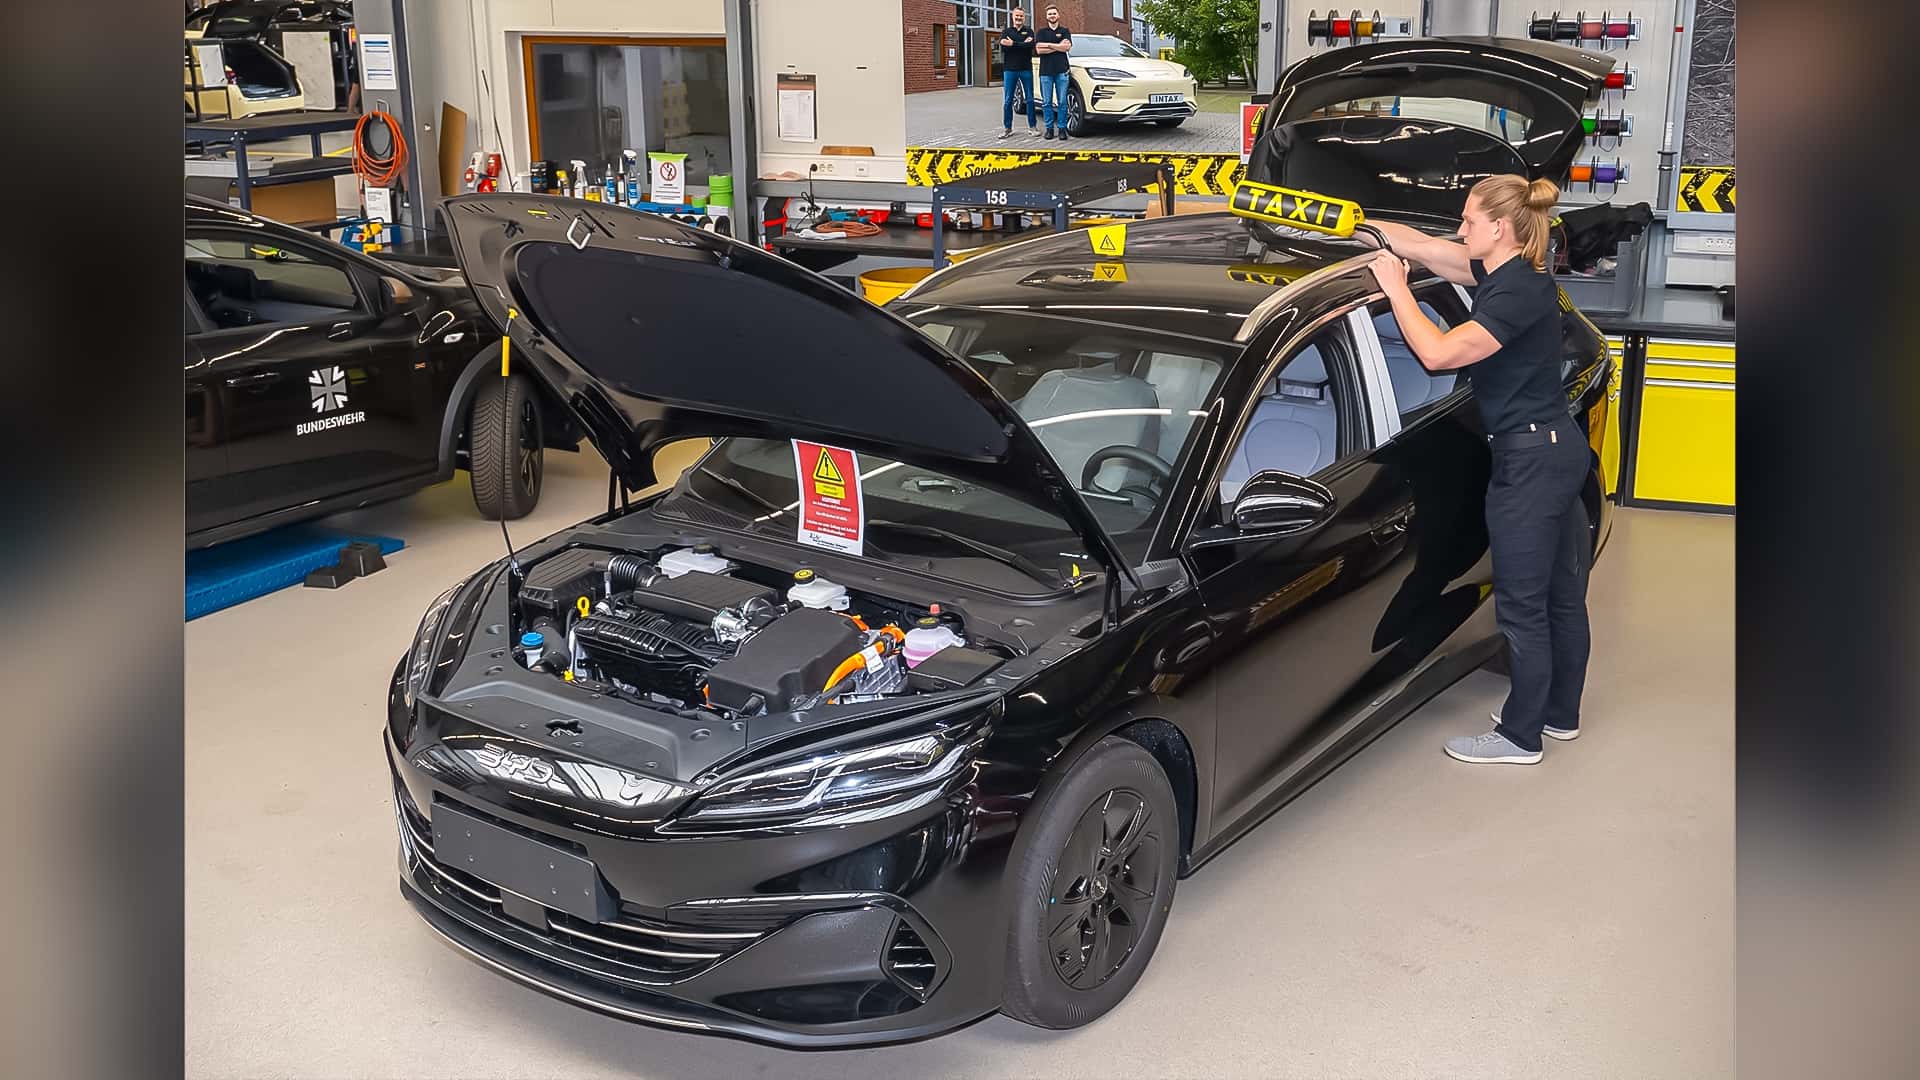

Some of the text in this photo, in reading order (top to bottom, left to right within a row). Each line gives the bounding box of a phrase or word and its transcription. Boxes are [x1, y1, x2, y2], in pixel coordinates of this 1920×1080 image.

[1155, 95, 1179, 103] INTAX
[985, 190, 1007, 205] 158
[1248, 188, 1328, 225] TAXI
[296, 411, 366, 436] BUNDESWEHR
